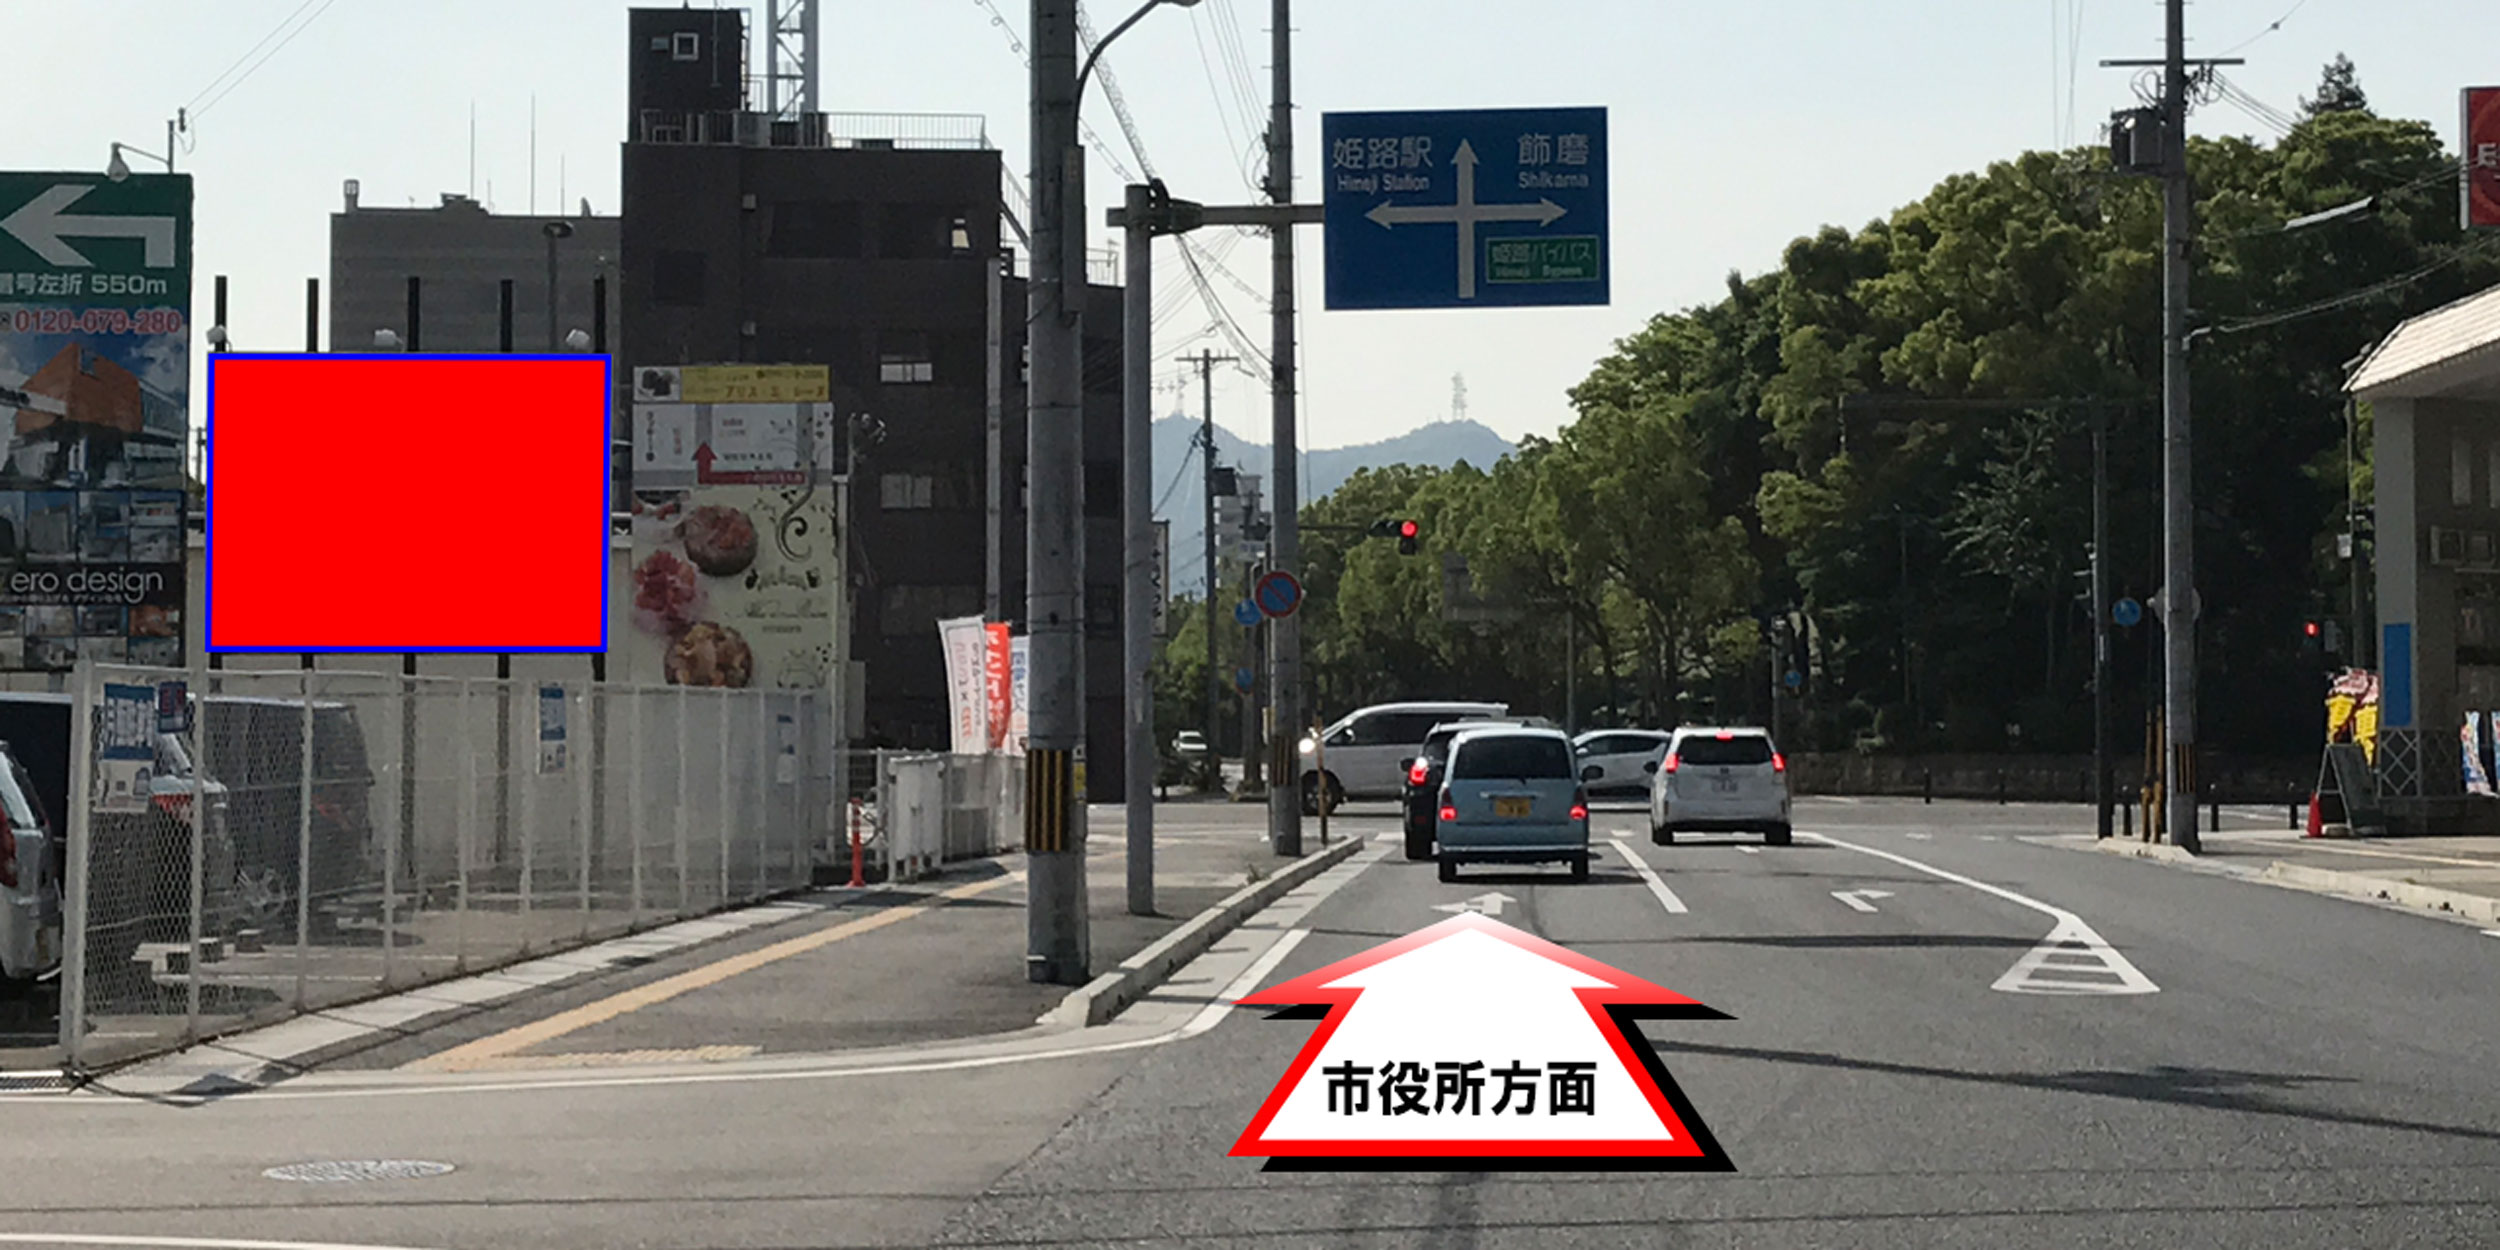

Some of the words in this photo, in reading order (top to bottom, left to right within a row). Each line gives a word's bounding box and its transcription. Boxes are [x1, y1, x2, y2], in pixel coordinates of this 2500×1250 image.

[1332, 136, 1433, 169] 姫路駅
[1337, 175, 1378, 194] Himeji
[1383, 174, 1430, 192] Station
[1518, 170, 1589, 188] Shikama
[91, 275, 167, 294] 550m
[14, 309, 182, 334] 0120-079-280
[66, 566, 164, 604] design
